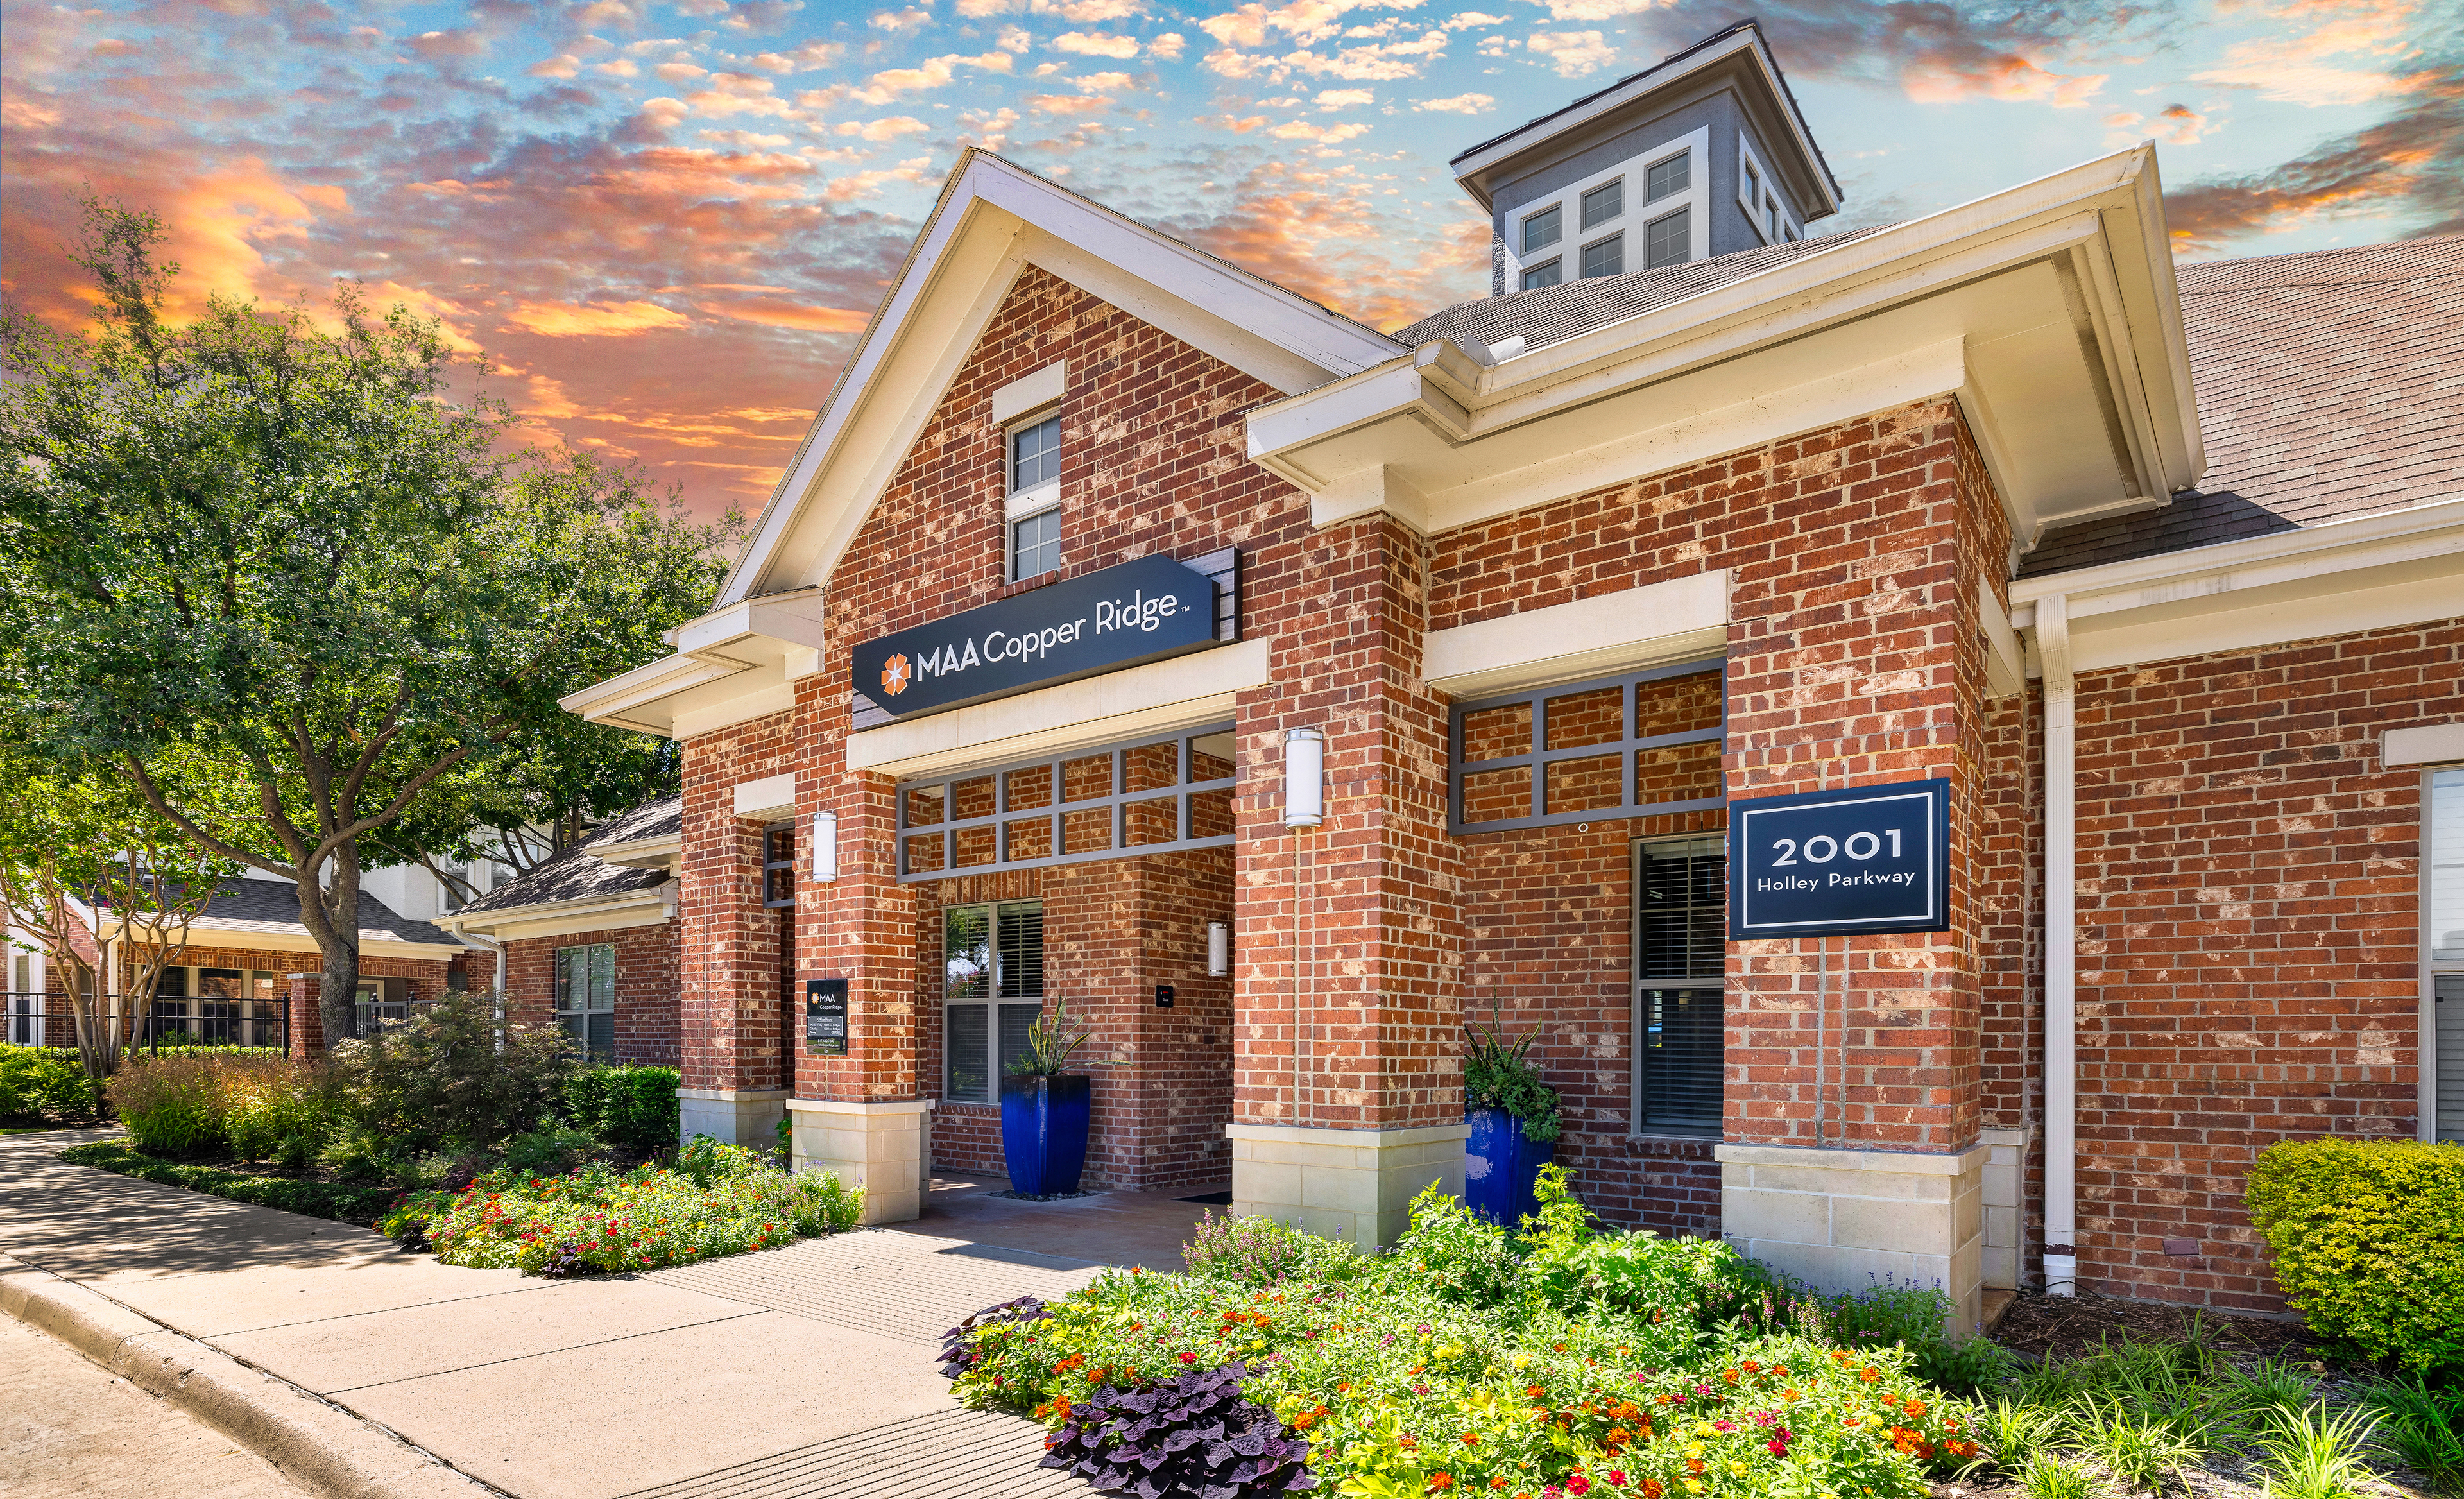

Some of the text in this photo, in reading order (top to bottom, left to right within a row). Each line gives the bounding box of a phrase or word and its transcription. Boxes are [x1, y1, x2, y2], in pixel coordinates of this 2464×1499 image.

[917, 637, 980, 682] MAA
[984, 616, 1086, 663] Copper
[1096, 589, 1178, 634] Ridge
[1771, 829, 1901, 866] 2001
[1758, 870, 1915, 892] Holley Parkway
[819, 994, 835, 1002] MAA
